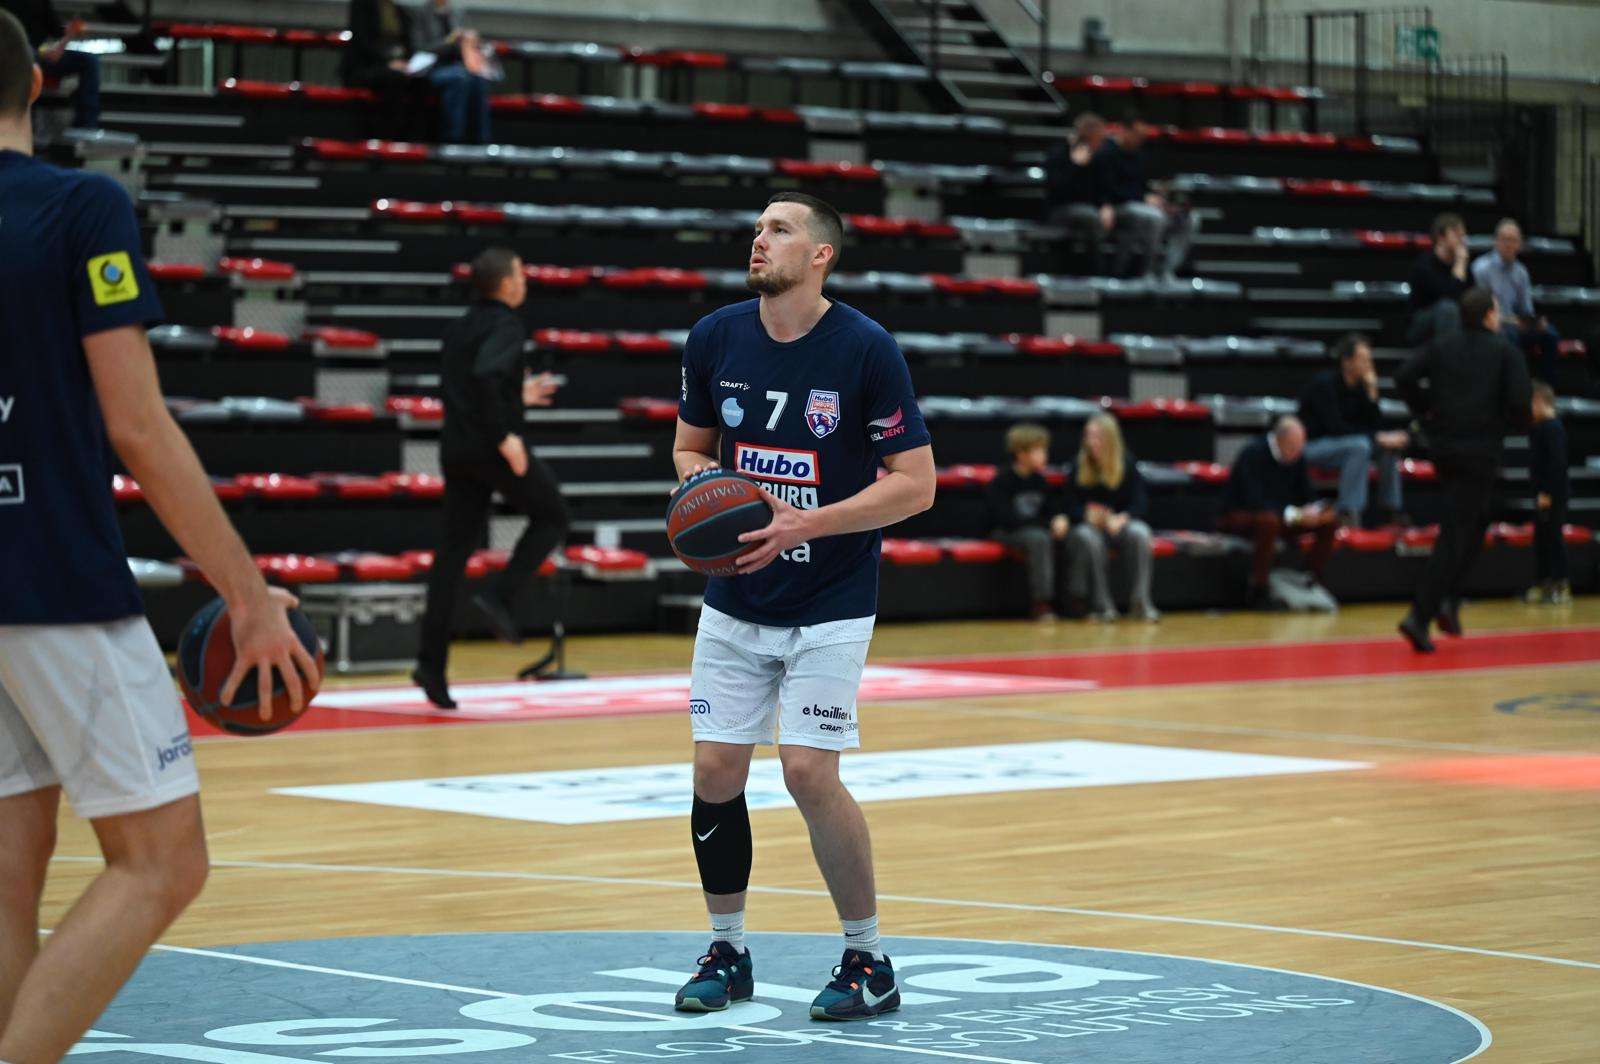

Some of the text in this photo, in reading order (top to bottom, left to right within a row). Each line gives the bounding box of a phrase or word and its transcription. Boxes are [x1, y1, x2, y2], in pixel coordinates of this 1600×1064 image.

[720, 380, 744, 390] CRAFT
[766, 390, 788, 432] 7
[740, 450, 811, 478] Hubo
[549, 983, 1259, 1063] FLOOR & ENERGY
[896, 994, 1355, 1048] SOLUTIONS
